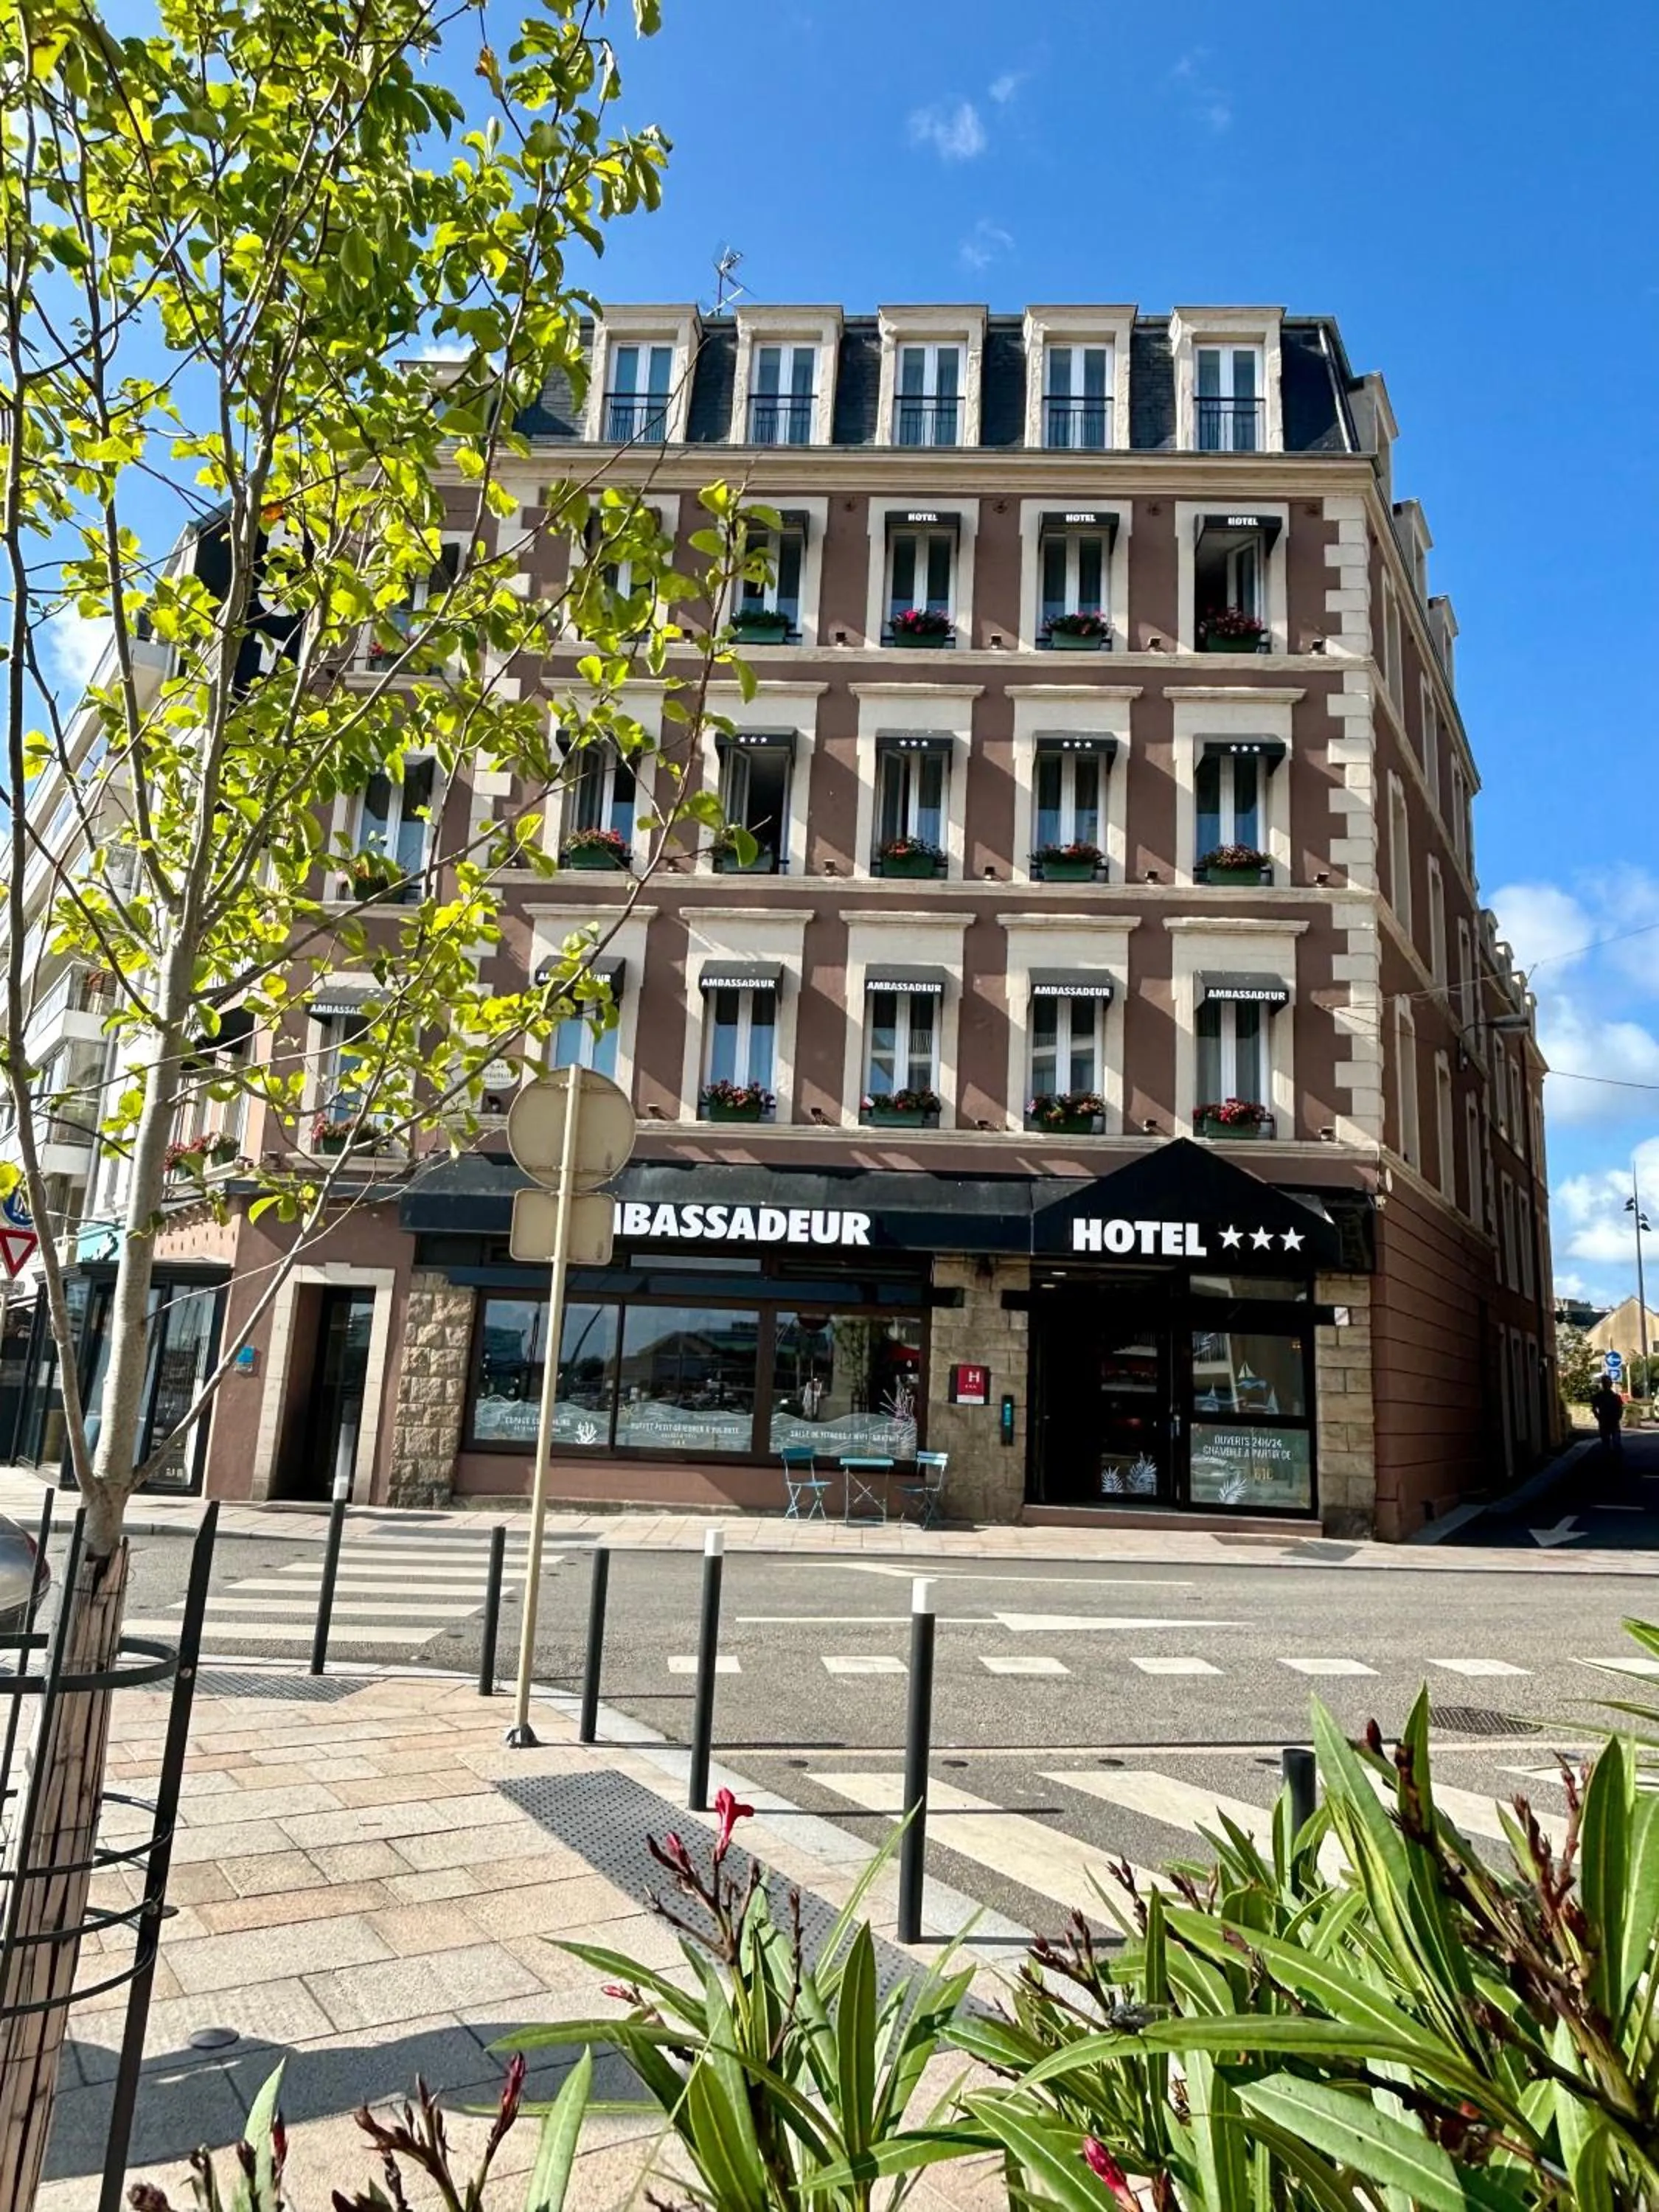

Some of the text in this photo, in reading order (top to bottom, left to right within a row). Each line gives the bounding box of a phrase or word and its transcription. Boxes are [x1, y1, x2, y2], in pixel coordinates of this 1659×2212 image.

[908, 512, 938, 521] HOTEL
[1065, 514, 1096, 522] HOTEL
[1228, 517, 1259, 526] HOTEL
[701, 978, 775, 988] AMBASSADEUR
[866, 981, 942, 992] AMBASSADEUR
[1034, 986, 1110, 996] AMBASSADEUR
[1208, 989, 1285, 1001] AMBASSADEUR
[613, 1202, 871, 1246] BASSADEUR
[1073, 1217, 1207, 1257] HOTEL
[968, 1371, 980, 1383] H
